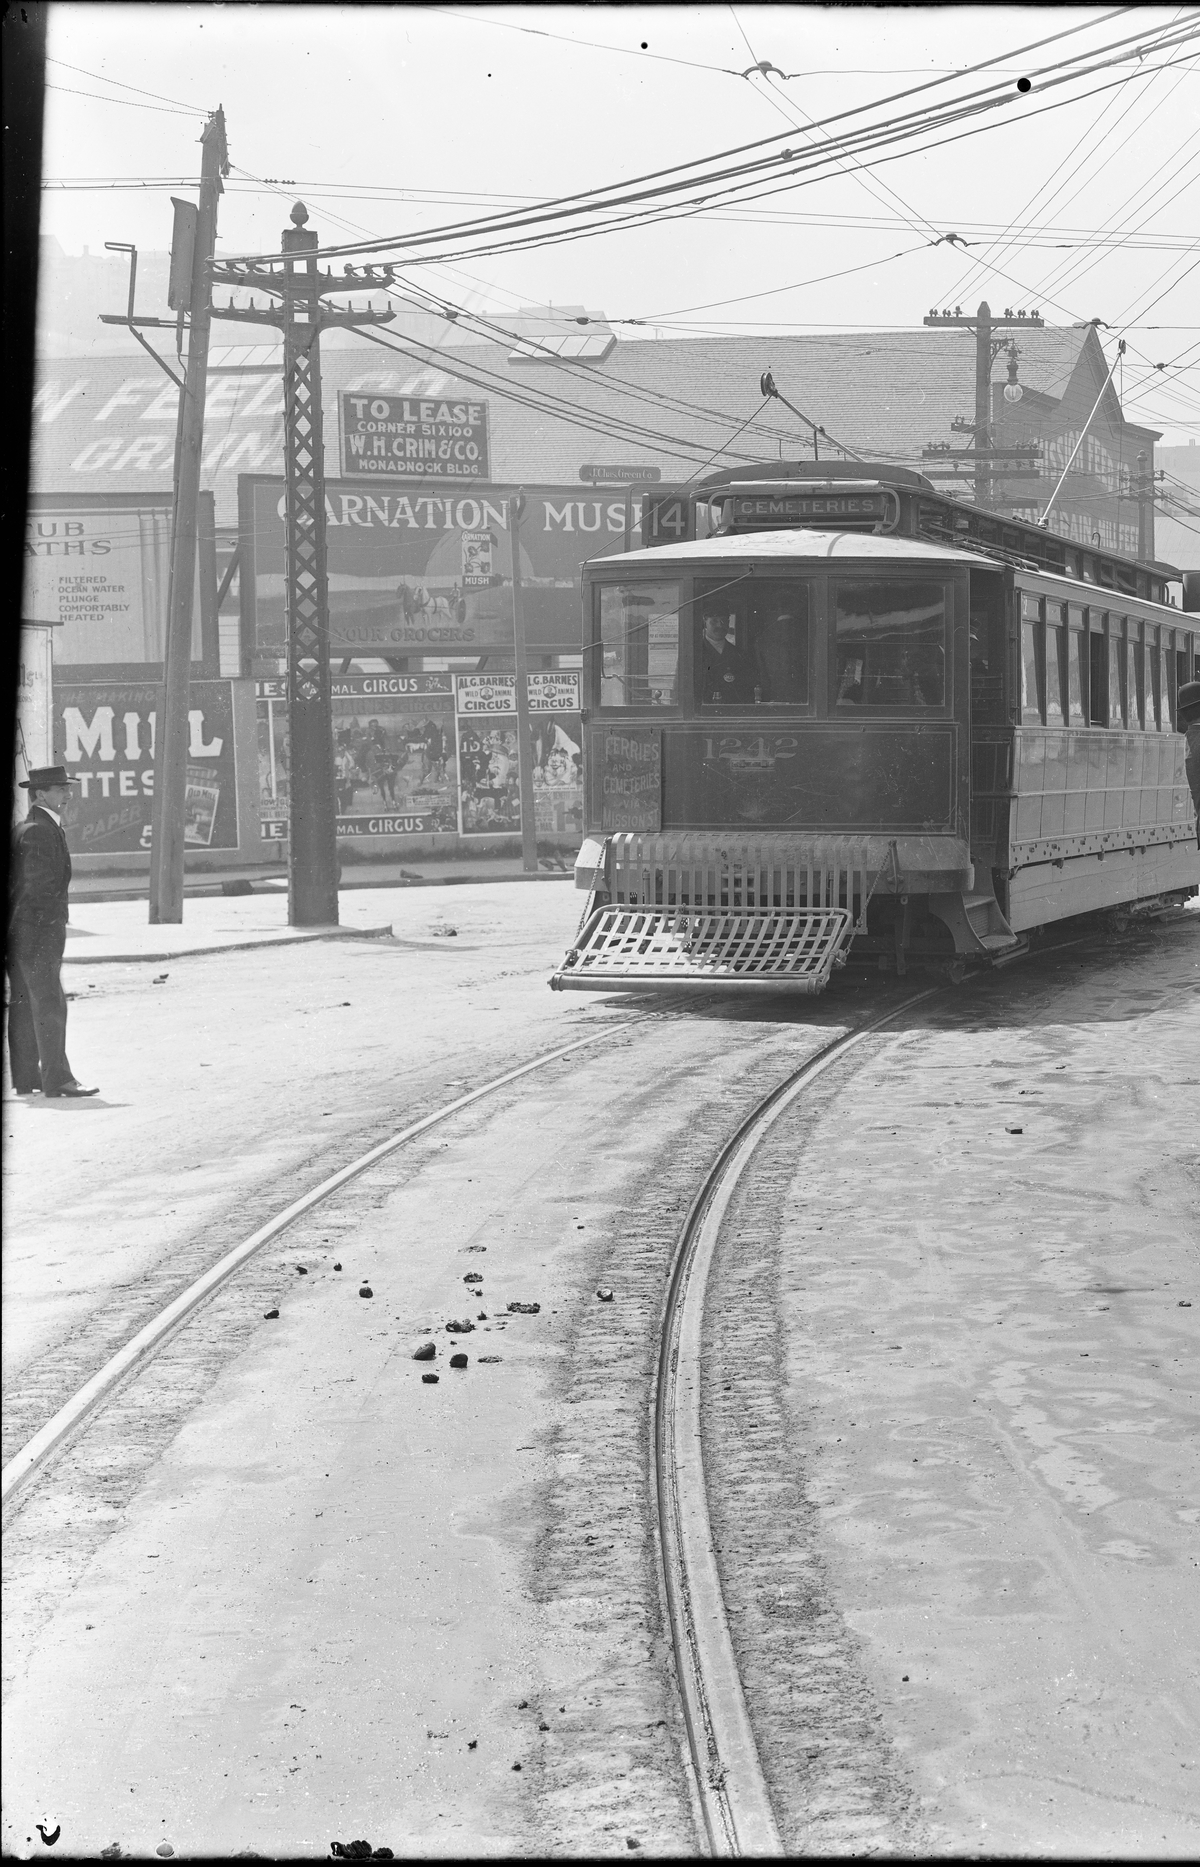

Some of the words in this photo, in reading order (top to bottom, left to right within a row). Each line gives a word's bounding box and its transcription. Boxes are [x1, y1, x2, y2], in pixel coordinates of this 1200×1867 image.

[350, 398, 390, 420] TO
[403, 401, 482, 426] LEASE
[357, 421, 416, 435] CORNER
[359, 459, 443, 474] MONADNOCK
[447, 463, 482, 475] BLDG.
[740, 499, 874, 514] CEMETERIES
[652, 503, 686, 536] 14
[27, 521, 85, 538] UB
[59, 575, 107, 584] FILTERED
[464, 577, 490, 585] MUSH
[58, 585, 88, 594] OCEAN
[92, 584, 125, 593] WATER
[59, 595, 99, 603] PLUNGE
[58, 604, 130, 613] COMFORTABLY
[59, 613, 105, 622] HEATED
[390, 626, 476, 642] GROCERS
[363, 678, 418, 693] CIRCUS
[464, 698, 511, 711] CIRCUS
[528, 697, 574, 709] CIRCUS
[605, 736, 659, 763] FERRIES
[703, 736, 799, 760] 1242
[612, 763, 632, 773] AND
[603, 772, 660, 795] CEMETERIES
[188, 787, 201, 798] OLD
[622, 799, 640, 809] VIA
[81, 805, 142, 841] PAPER
[603, 806, 647, 828] MISSION
[368, 817, 424, 833] CIRCUS
